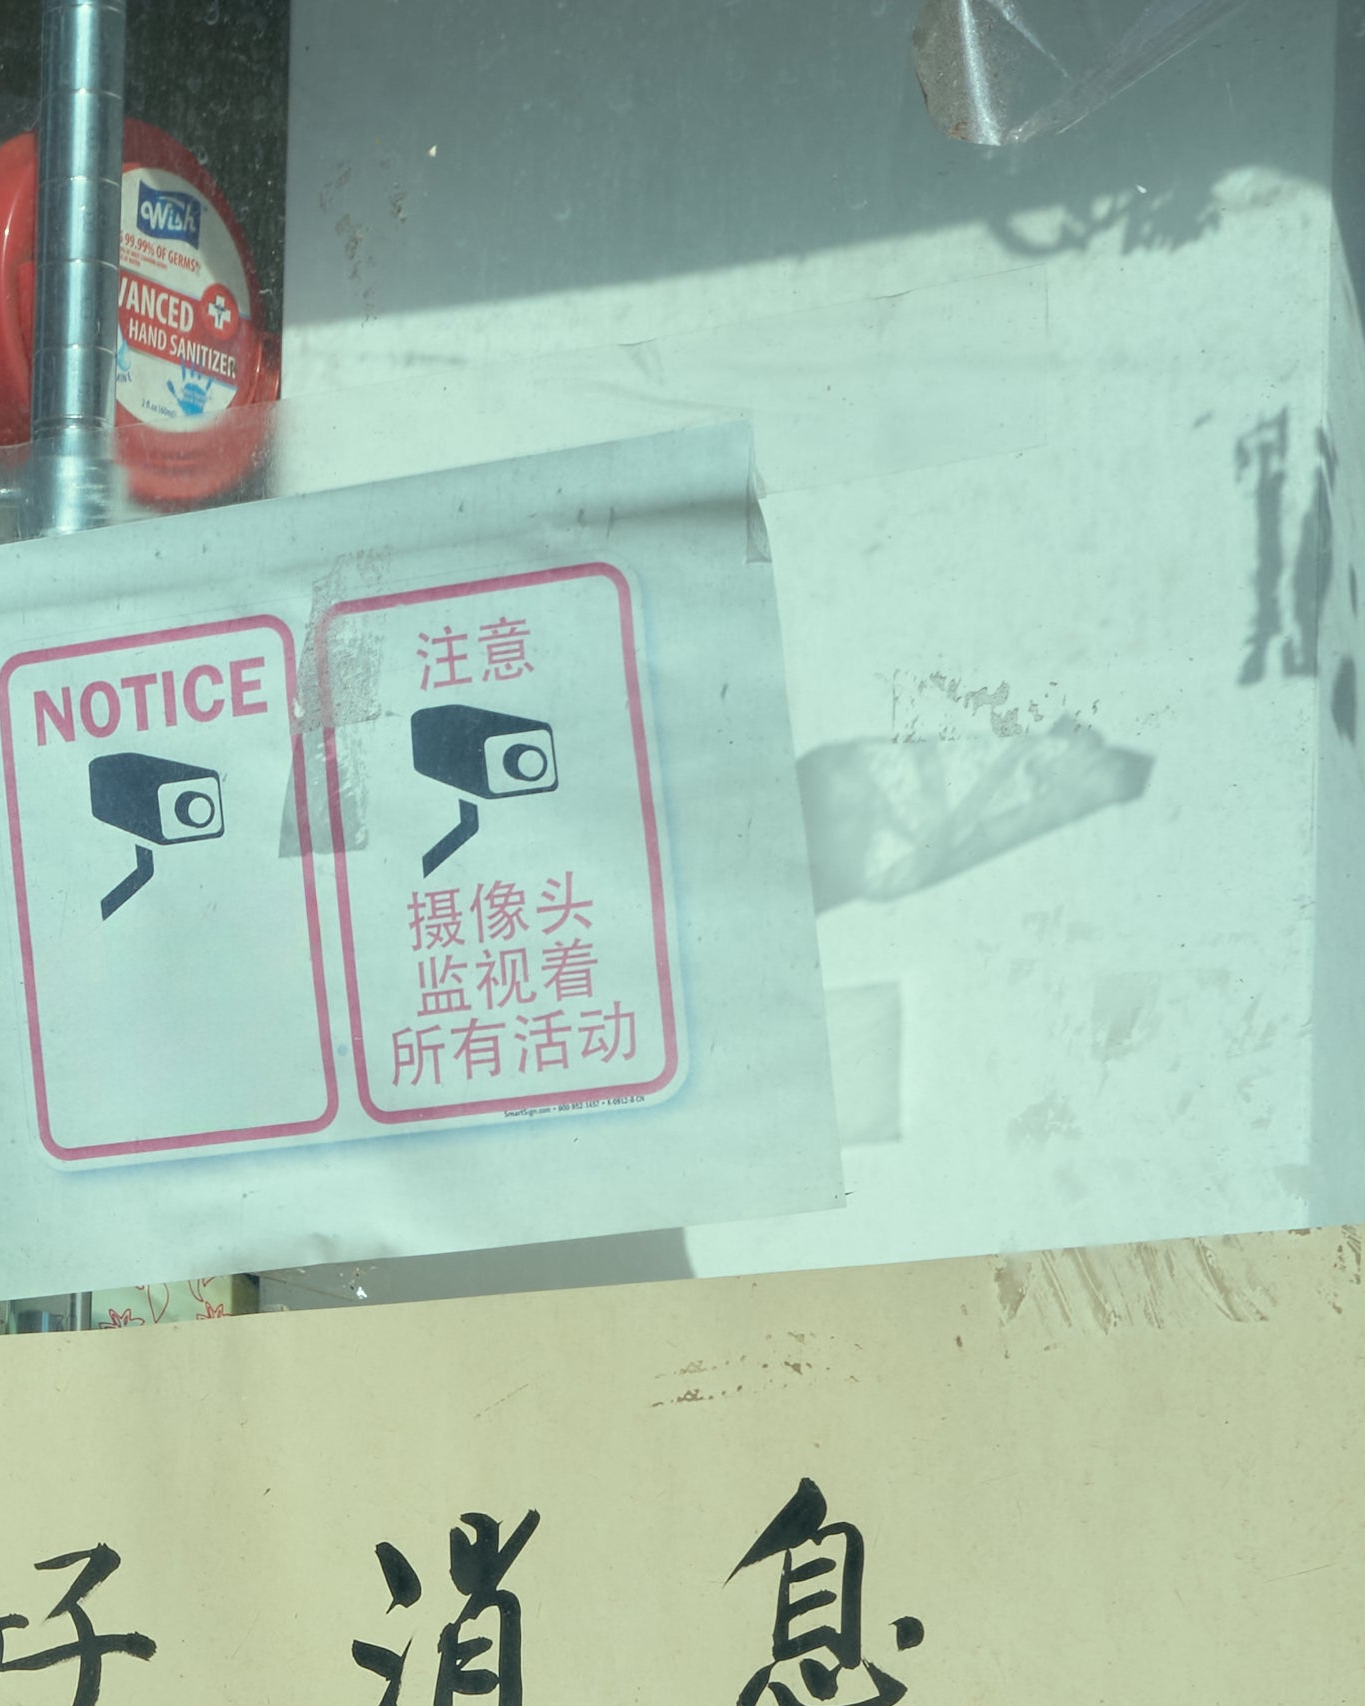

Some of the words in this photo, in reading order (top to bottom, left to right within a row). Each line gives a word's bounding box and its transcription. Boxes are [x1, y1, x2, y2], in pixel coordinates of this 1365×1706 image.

[140, 194, 197, 233] Wish
[156, 245, 167, 260] OF
[129, 317, 167, 351] HAND
[170, 336, 236, 379] SANITIZER
[415, 615, 536, 693] 注意
[32, 655, 269, 747] NOTICE
[407, 871, 595, 952] 摄像头
[416, 940, 598, 1019] 监视着
[390, 1001, 637, 1089] 所有活动
